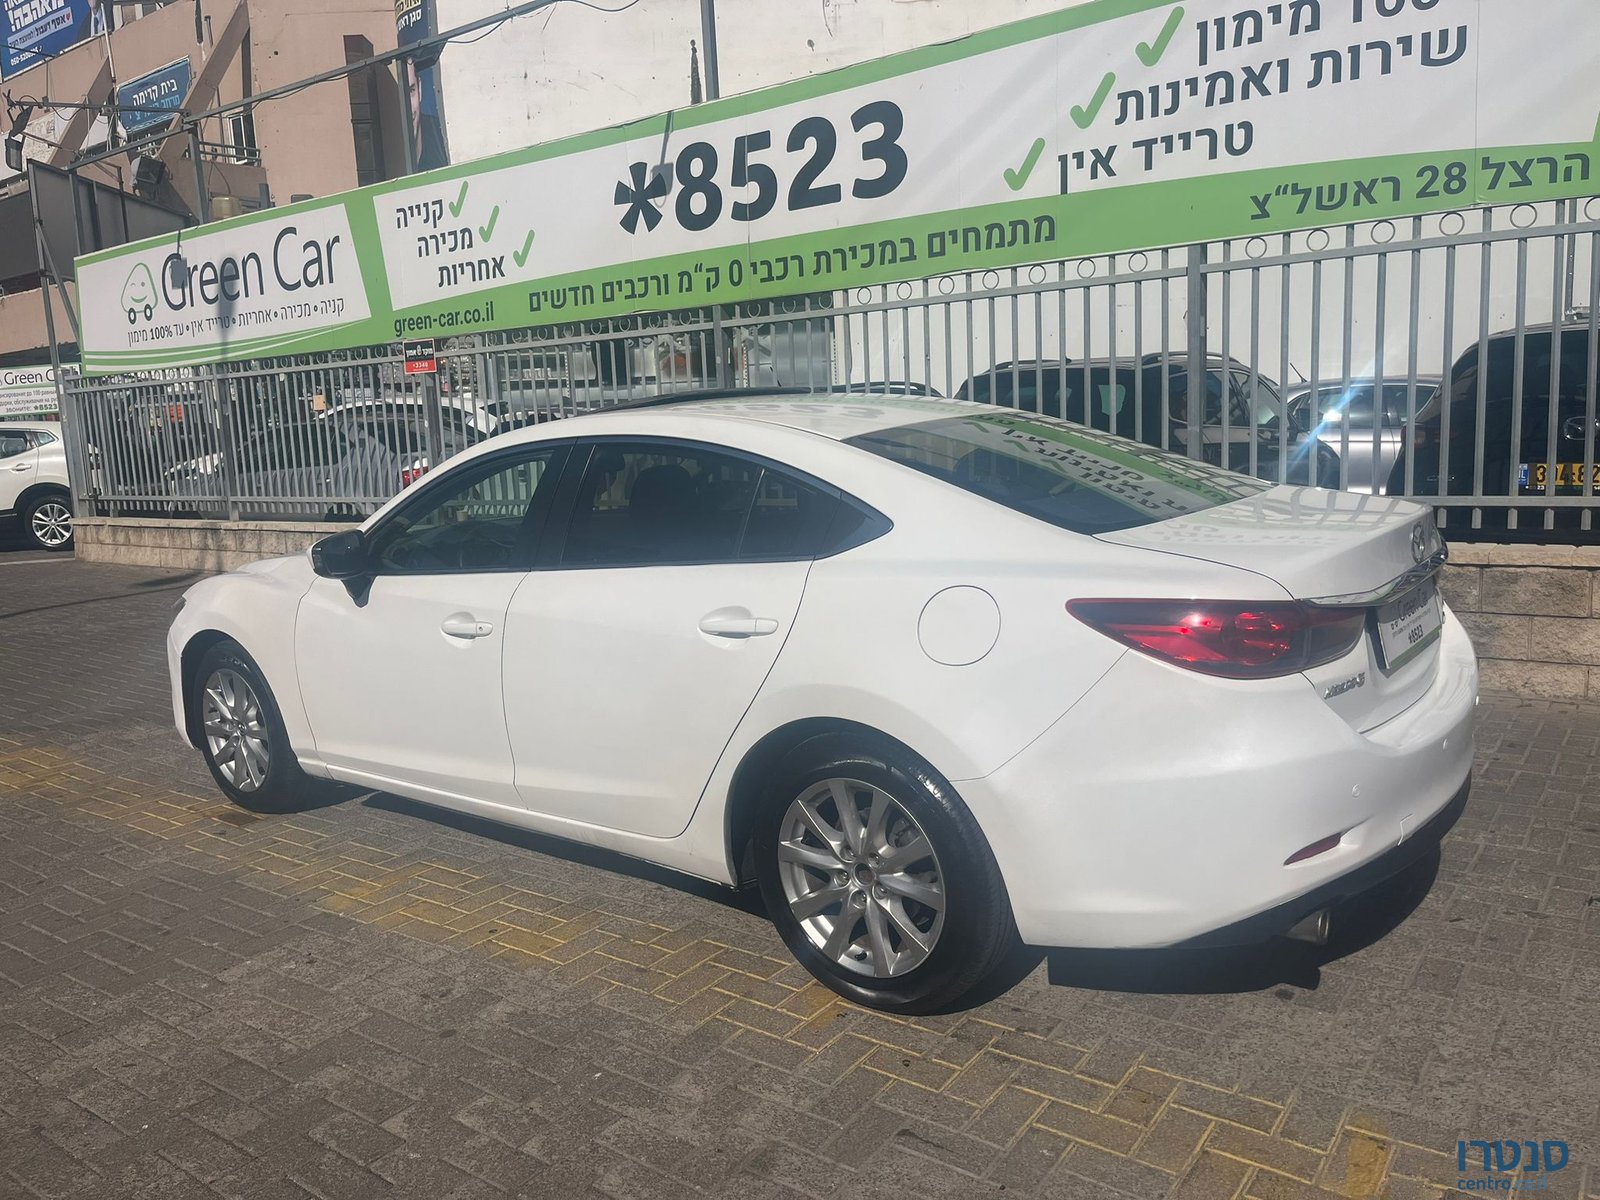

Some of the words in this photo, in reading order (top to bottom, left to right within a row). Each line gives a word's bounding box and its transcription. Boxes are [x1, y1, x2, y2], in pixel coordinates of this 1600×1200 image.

[1197, 0, 1320, 66] מימון
[1307, 25, 1467, 89] שירות
[132, 85, 159, 106] קדימה
[160, 79, 178, 95] בית
[1114, 58, 1289, 125] ואמינות
[1132, 120, 1254, 171] טרייד
[1058, 145, 1117, 195] אין
[1415, 161, 1467, 199] 28
[1481, 152, 1590, 190] הרצל
[396, 199, 444, 229] קנייה
[417, 227, 473, 258] מכירה
[927, 215, 1055, 258] מתמחים
[161, 252, 265, 311] Green
[273, 226, 340, 291] Car
[750, 255, 804, 283] רכבי
[813, 237, 917, 276] במכירת
[438, 255, 506, 288] אחריות
[729, 259, 743, 287] 0
[529, 284, 594, 312] חדשים
[602, 273, 669, 302] ורכבים
[238, 309, 272, 327] אחריות
[280, 303, 311, 320] מכירה
[320, 298, 345, 317] קניה
[393, 301, 495, 337] green-car.co.il
[128, 329, 148, 347] מימון
[150, 324, 173, 340] 100%
[173, 323, 184, 336] עד
[190, 320, 204, 337] אין
[205, 316, 230, 331] טרייד
[4, 371, 43, 385] Green
